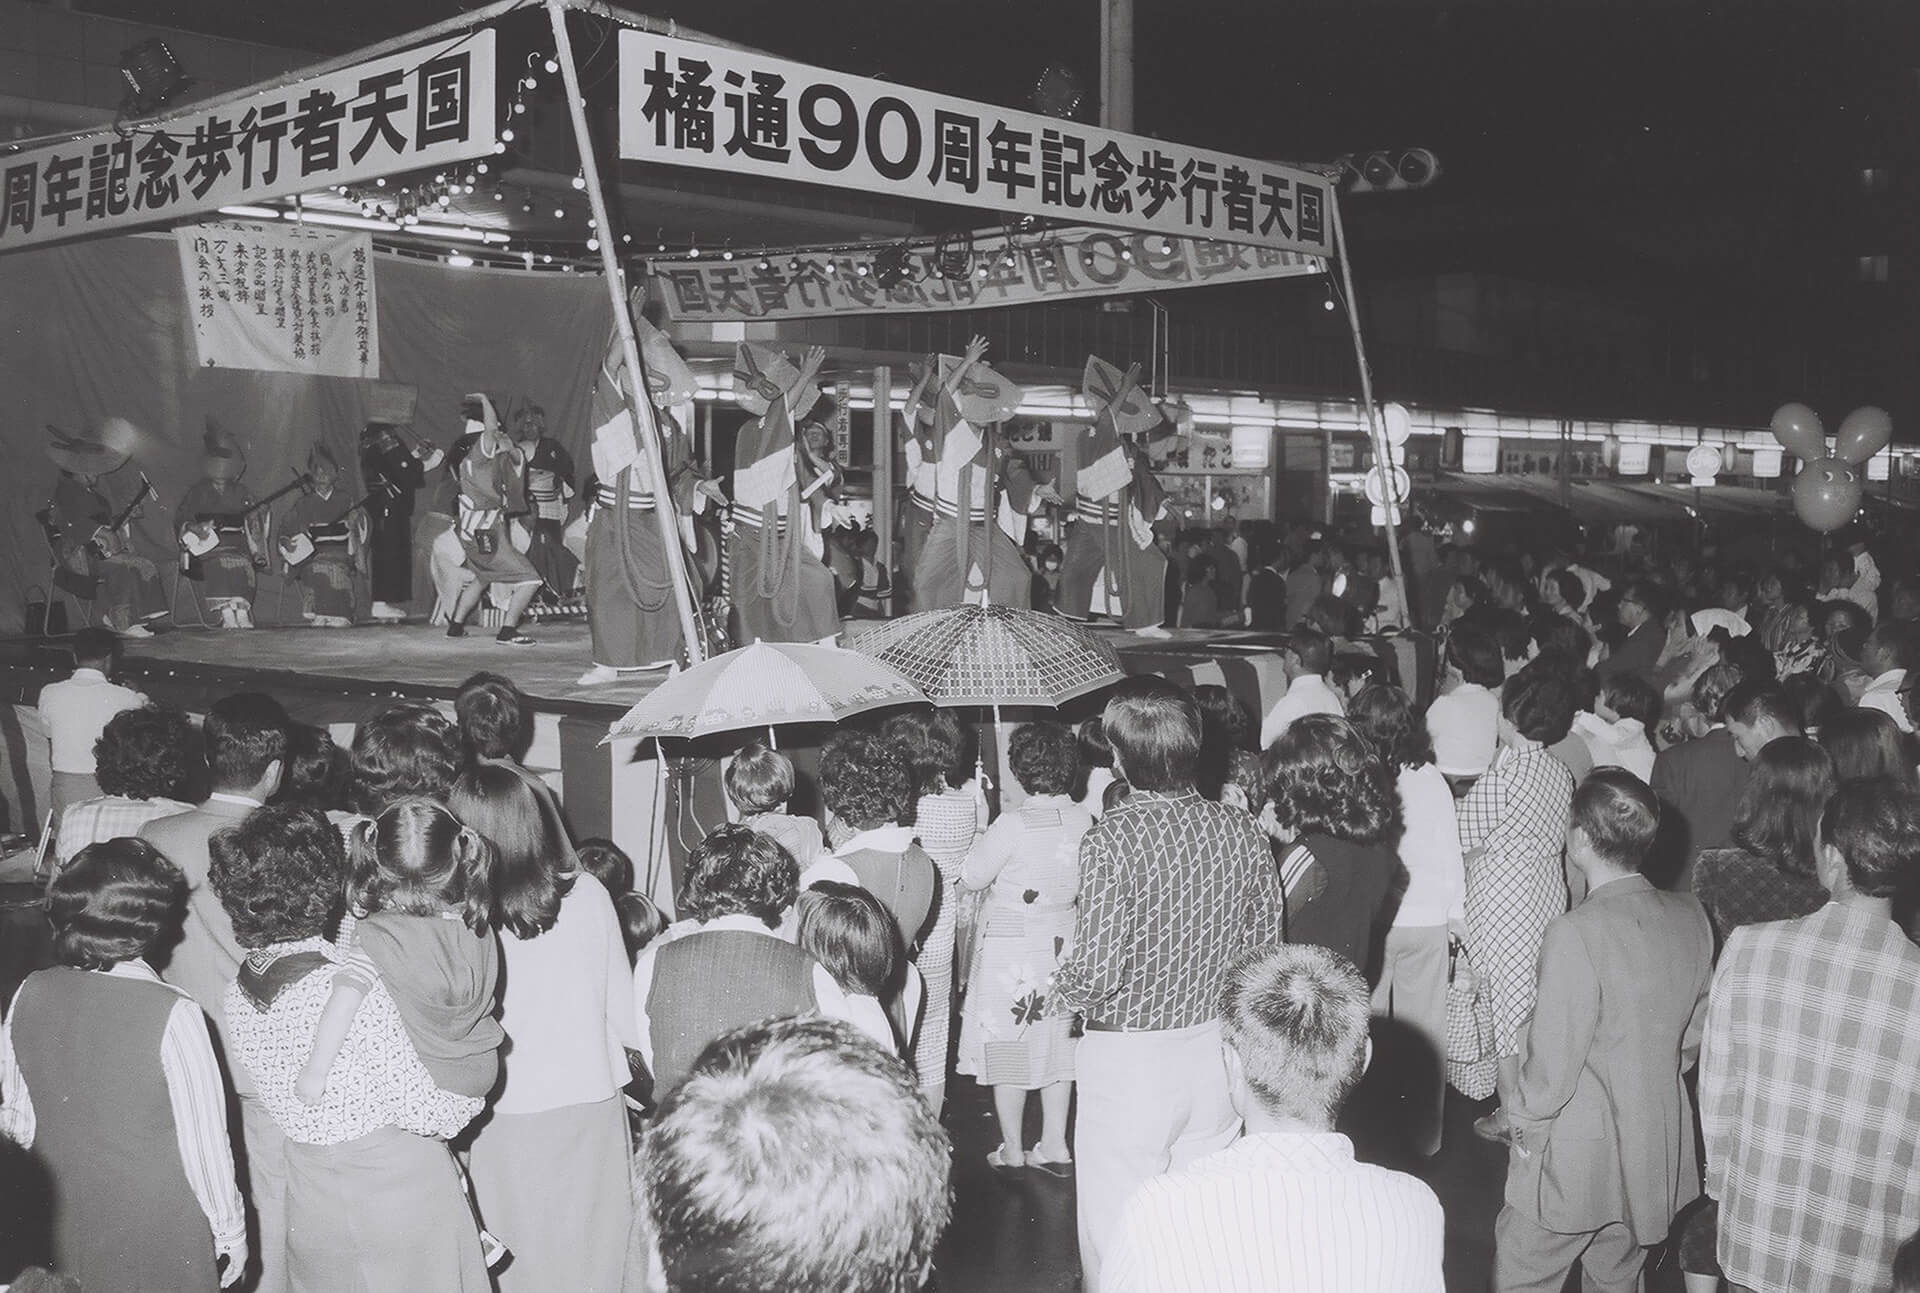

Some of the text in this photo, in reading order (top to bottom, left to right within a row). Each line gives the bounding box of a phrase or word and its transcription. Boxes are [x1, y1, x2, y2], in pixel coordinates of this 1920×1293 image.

[0, 51, 471, 235] 周年記念歩行者天国
[641, 49, 1325, 246] 橘通90周年記念歩行者天国
